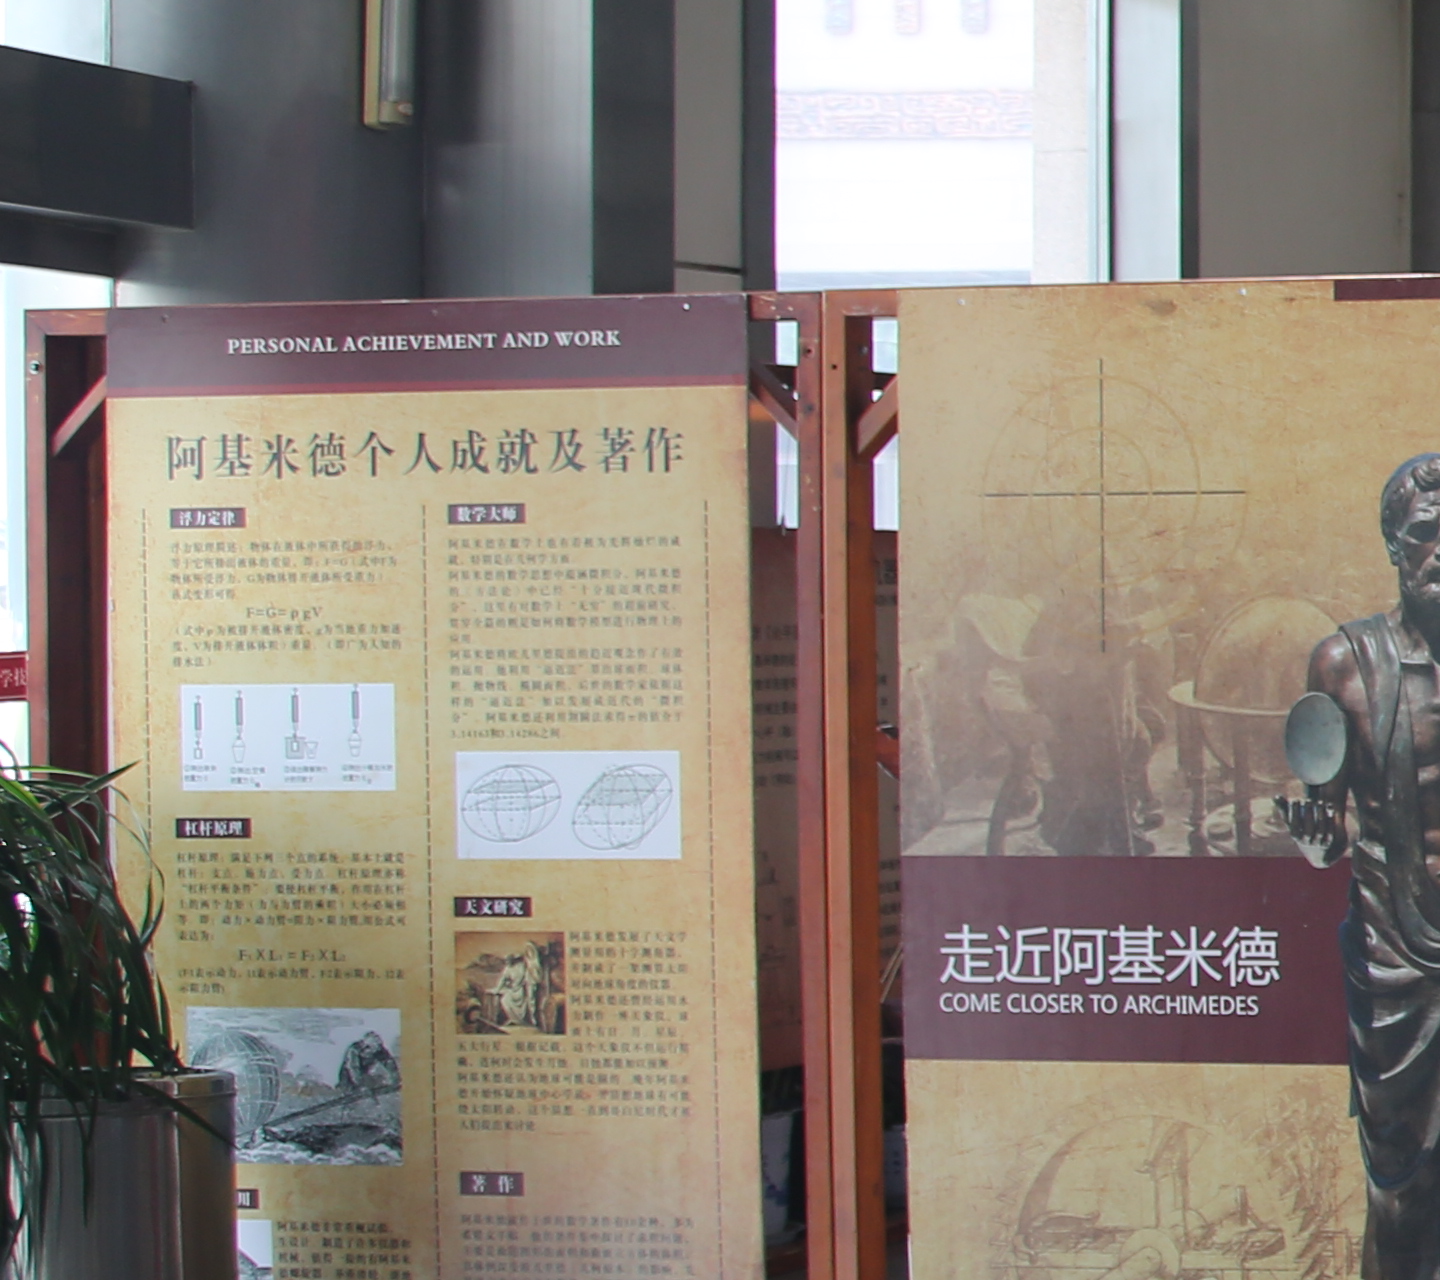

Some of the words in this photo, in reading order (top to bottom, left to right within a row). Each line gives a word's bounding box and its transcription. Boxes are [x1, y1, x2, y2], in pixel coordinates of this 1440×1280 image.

[227, 336, 338, 354] PERSONAL
[342, 333, 497, 352] ACHIEVEMENT
[503, 331, 549, 349] AND
[554, 329, 620, 347] WORK
[167, 424, 685, 481] 阿基米德个人成就及著作
[179, 509, 236, 527] 浮力定律
[457, 506, 517, 523] 数学大师
[185, 820, 243, 837] 杠杆原理
[465, 898, 524, 916] 天文研究
[940, 923, 1281, 988] 走近阿基米德
[940, 992, 1001, 1014] COME
[1006, 993, 1085, 1015] CLOSER
[1089, 994, 1118, 1015] TO
[1123, 994, 1260, 1016] ARCHIMEDES
